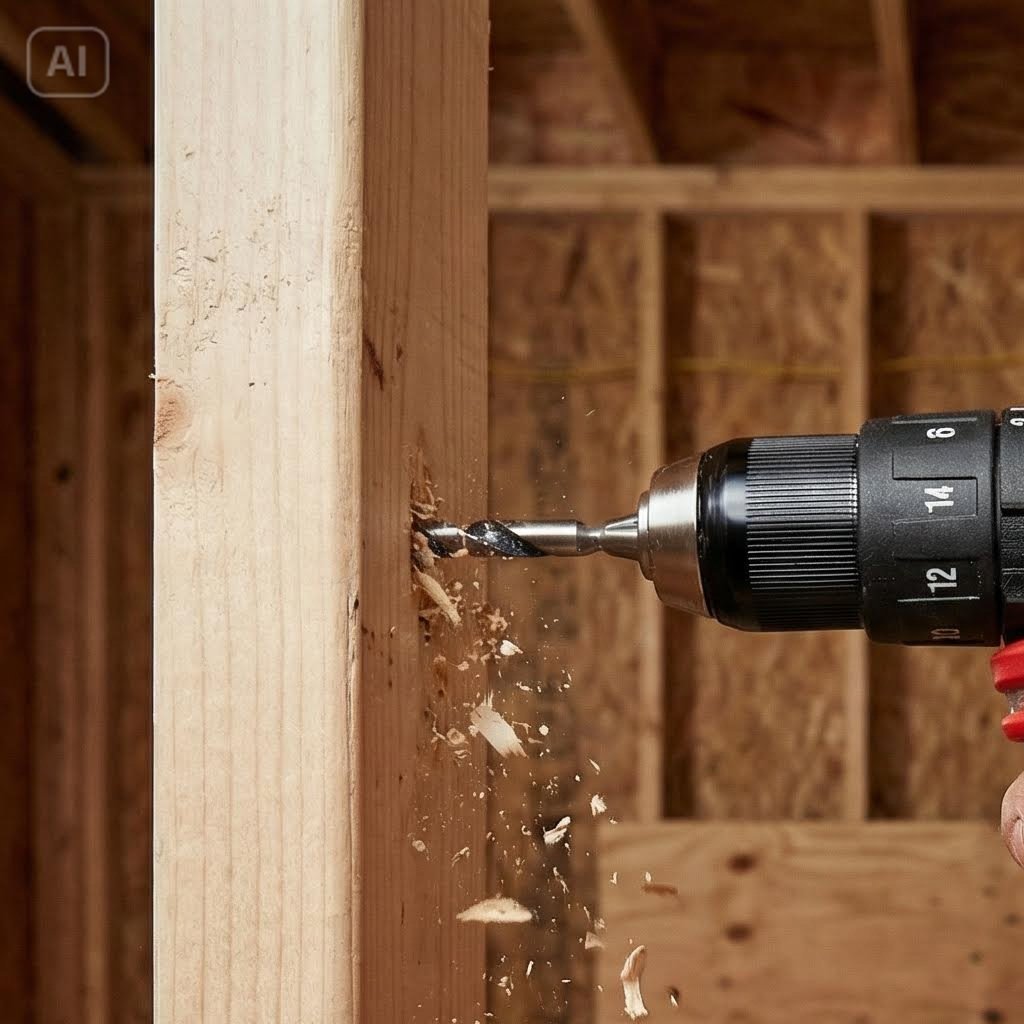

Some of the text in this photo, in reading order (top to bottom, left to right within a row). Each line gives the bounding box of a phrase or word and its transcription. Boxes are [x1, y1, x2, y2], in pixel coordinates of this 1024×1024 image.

[926, 427, 956, 439] 6
[924, 485, 955, 513] 14
[926, 567, 958, 593] 12
